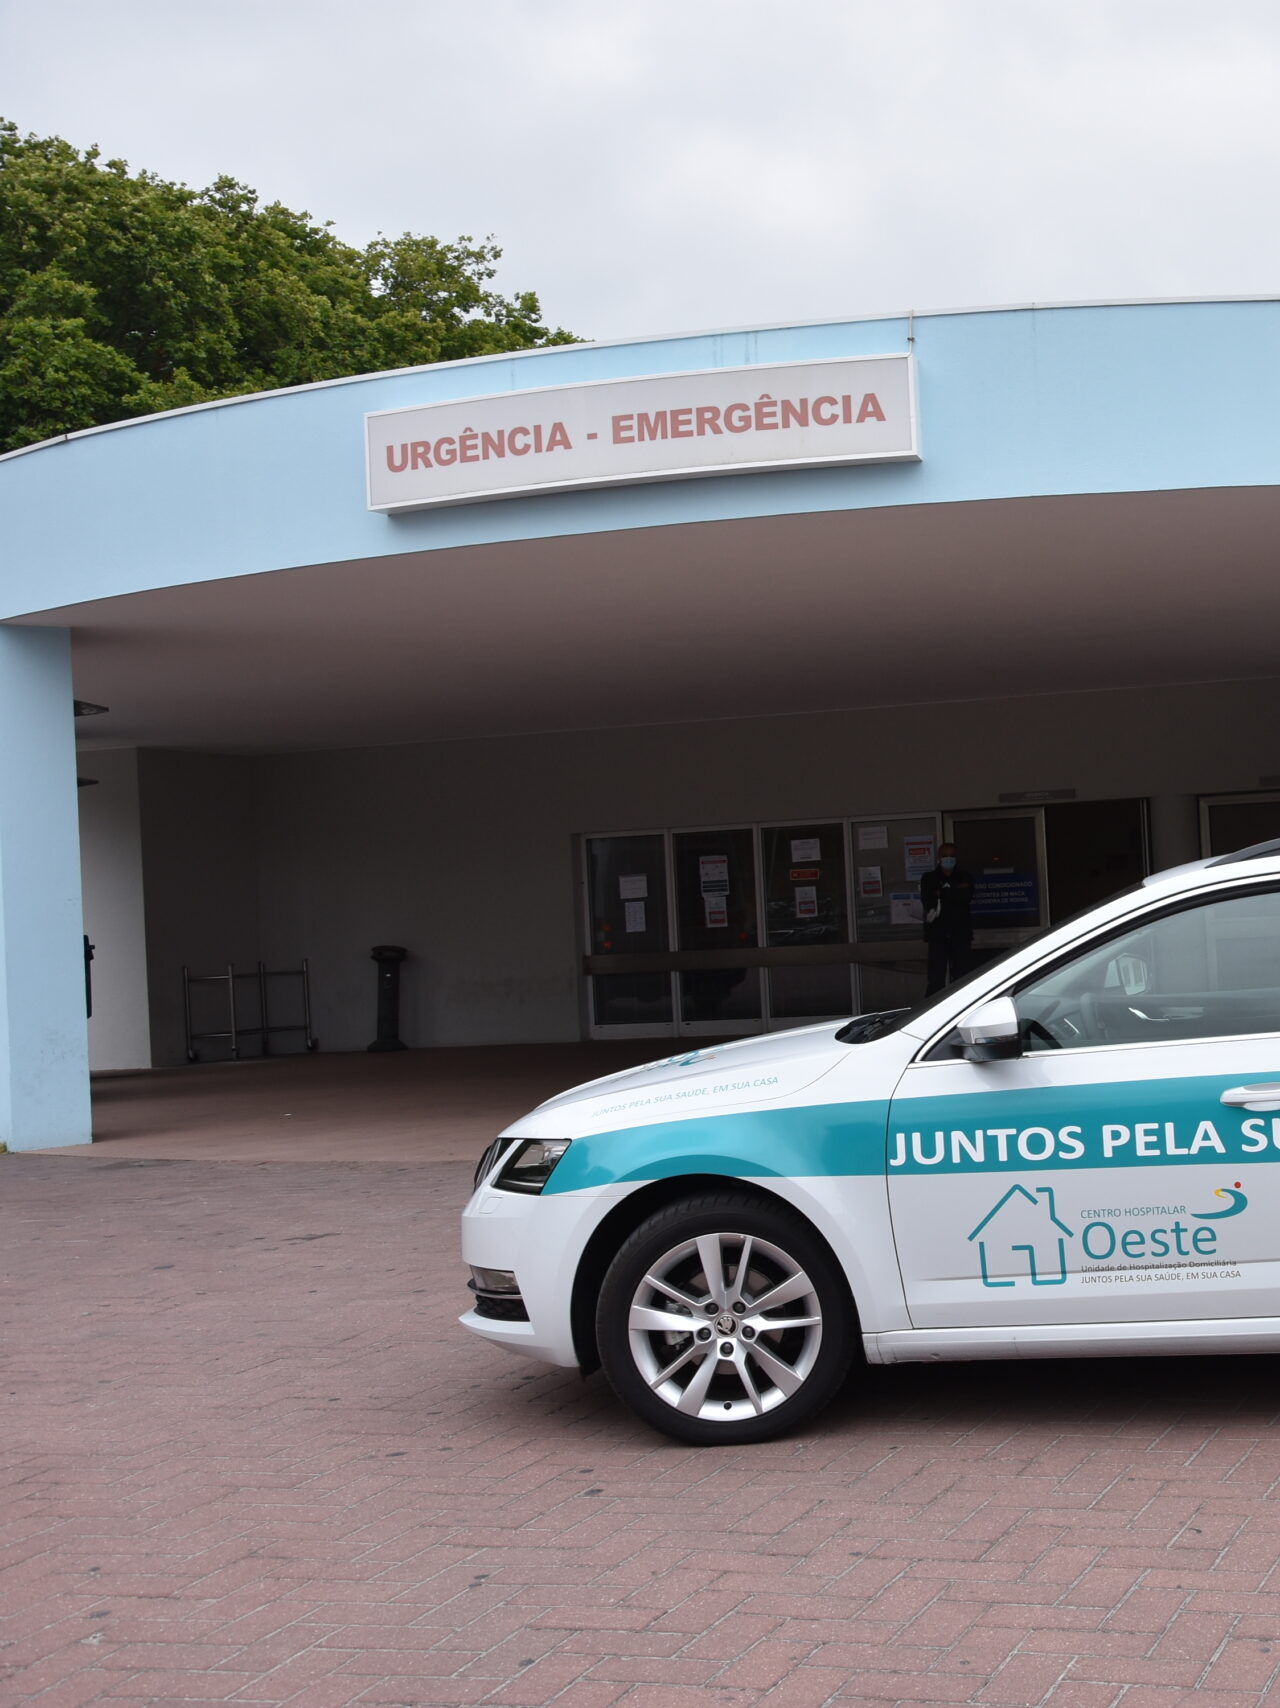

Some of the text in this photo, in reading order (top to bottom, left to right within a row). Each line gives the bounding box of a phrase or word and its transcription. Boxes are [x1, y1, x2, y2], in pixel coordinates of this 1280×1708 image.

[386, 421, 573, 474] URGÊNCIA
[611, 392, 887, 446] EMERGÊNCIA
[592, 1076, 779, 1118] JUNTOS PELA SUA SAÚDE, EM SUA CASA
[890, 1125, 1085, 1168] JUNTOS
[1102, 1120, 1226, 1158] PELA
[1080, 1205, 1186, 1219] CENTRO HOSPITALAR
[1081, 1220, 1217, 1260] Oeste
[1081, 1259, 1237, 1273] Unidade de Hospitalização Domiciliária
[1081, 1269, 1241, 1284] JUNTOS PELA SUA SAÚDE, EM SUA CASA
